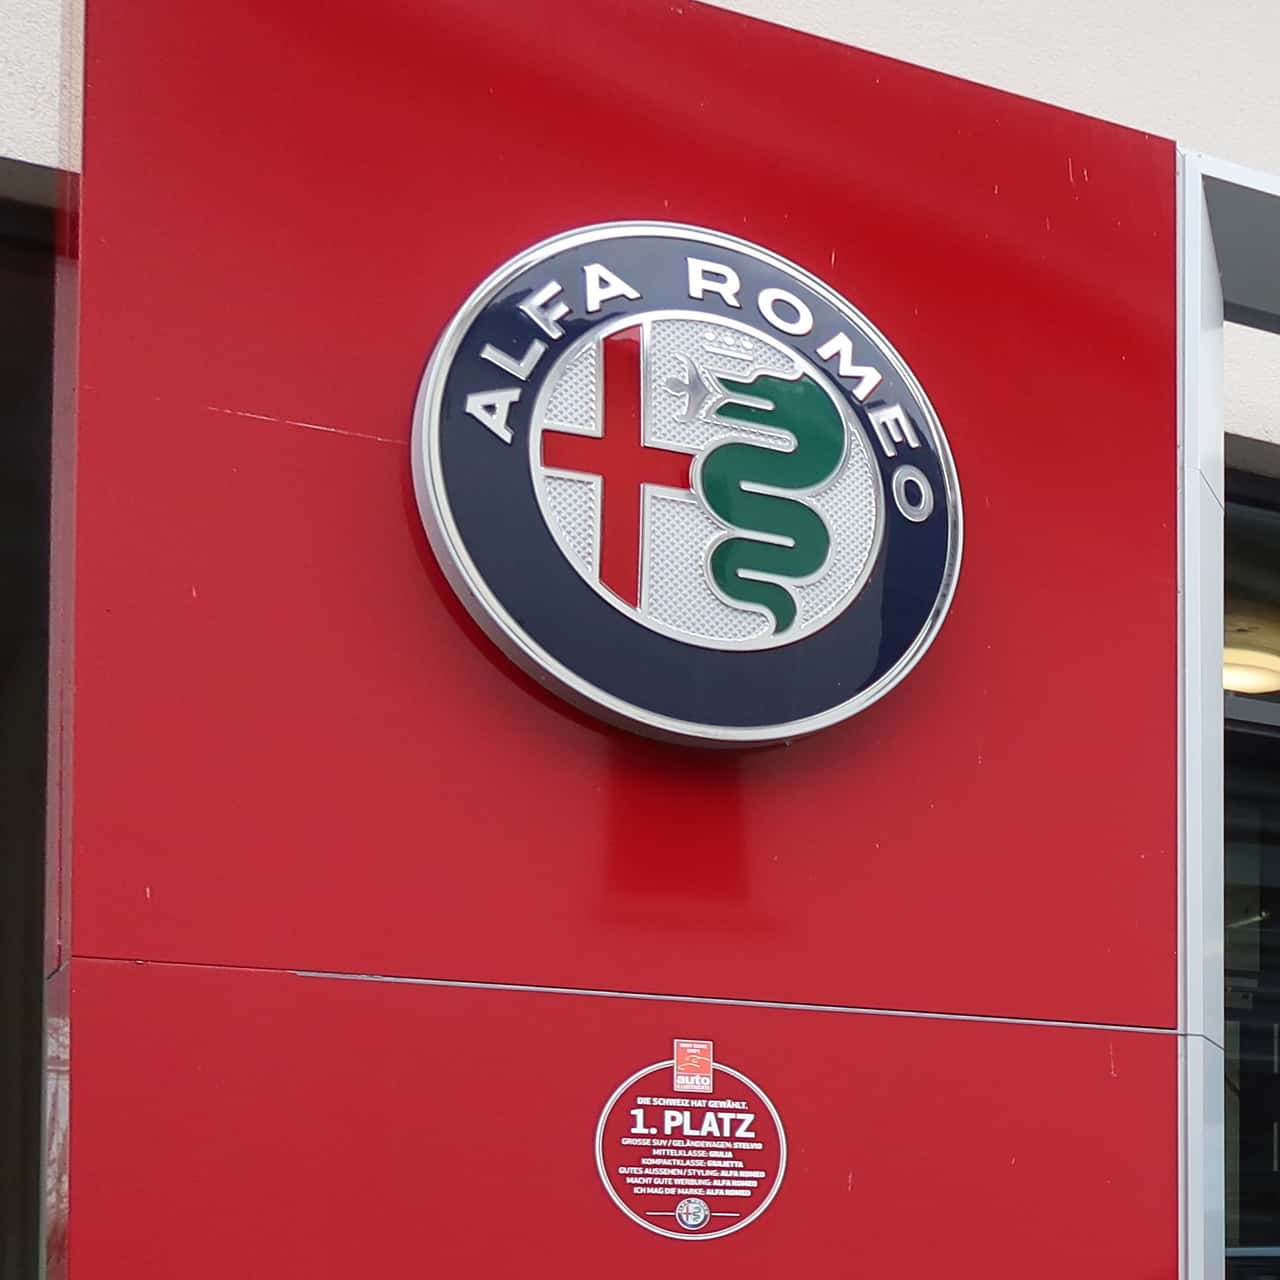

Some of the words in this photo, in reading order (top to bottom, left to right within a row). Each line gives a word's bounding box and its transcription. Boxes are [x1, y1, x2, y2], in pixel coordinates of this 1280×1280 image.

[466, 263, 640, 444] ALFA
[687, 257, 934, 523] ROMEO
[677, 1074, 711, 1086] auto
[636, 1096, 652, 1105] DIE
[653, 1097, 690, 1106] SCHWEIZ
[691, 1099, 707, 1107] HAT
[630, 1108, 657, 1134] 1.
[664, 1110, 755, 1138] PLATZ
